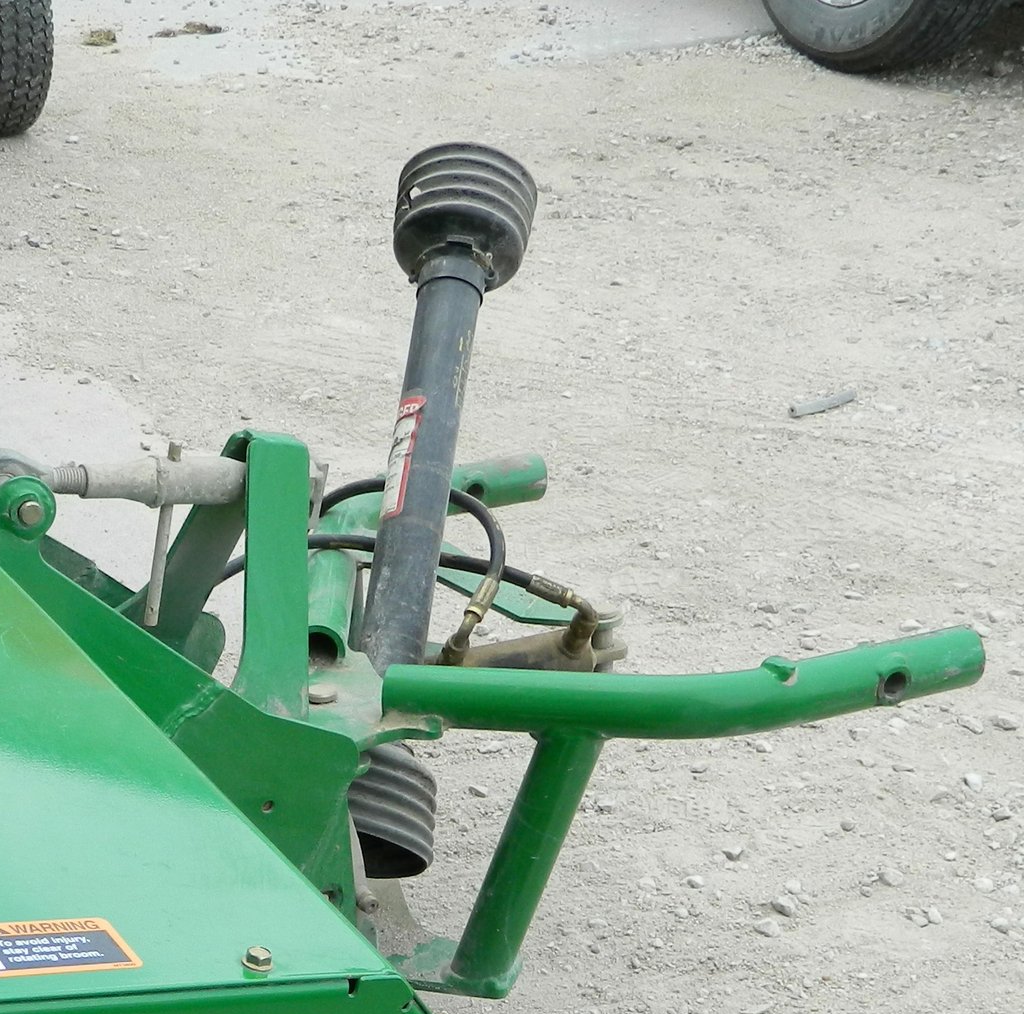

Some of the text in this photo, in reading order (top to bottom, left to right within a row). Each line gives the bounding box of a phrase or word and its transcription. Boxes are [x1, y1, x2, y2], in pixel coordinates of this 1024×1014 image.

[8, 920, 100, 934] WARNING
[14, 937, 50, 947] avoid
[51, 935, 91, 945] injury,
[2, 943, 79, 956] stay clear of
[8, 950, 105, 963] rotating broom.
